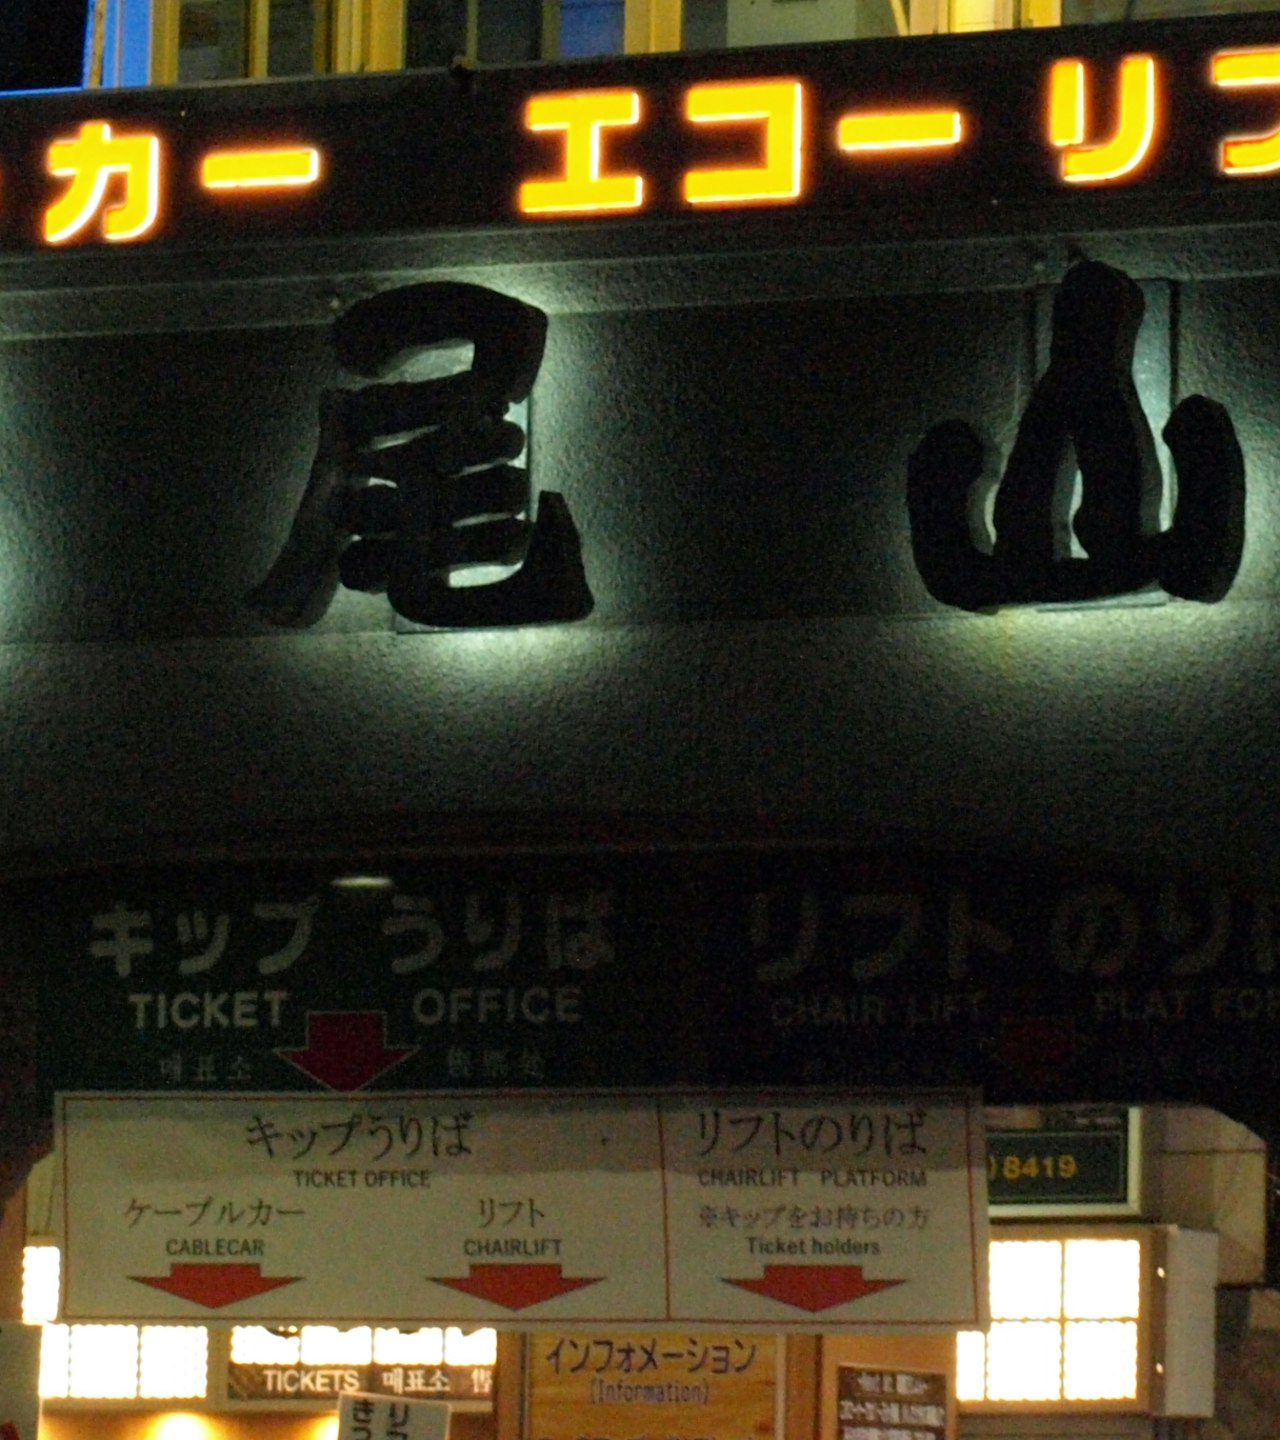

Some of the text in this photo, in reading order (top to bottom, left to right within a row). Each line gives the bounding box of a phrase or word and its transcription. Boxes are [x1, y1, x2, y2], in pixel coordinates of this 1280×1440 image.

[89, 895, 318, 979] キップ
[128, 987, 582, 1030] TICKET OFFICE
[246, 1113, 474, 1160] キップうりば
[697, 1112, 928, 1157] リフトのりば
[293, 1170, 432, 1189] TICKET OFFICE
[698, 1168, 928, 1188] CHAIRLIFT PLATFORM
[125, 1195, 306, 1229] ケーブルカー
[477, 1197, 545, 1230] リフト
[166, 1239, 266, 1258] CABLECAR
[464, 1239, 563, 1258] CHAIRLIFT
[745, 1236, 881, 1255] Ticket holders
[546, 1338, 756, 1375] インフォメーション
[263, 1369, 361, 1392] TICKETS
[381, 1367, 451, 1394] 매표소
[590, 1380, 709, 1404] (Information)
